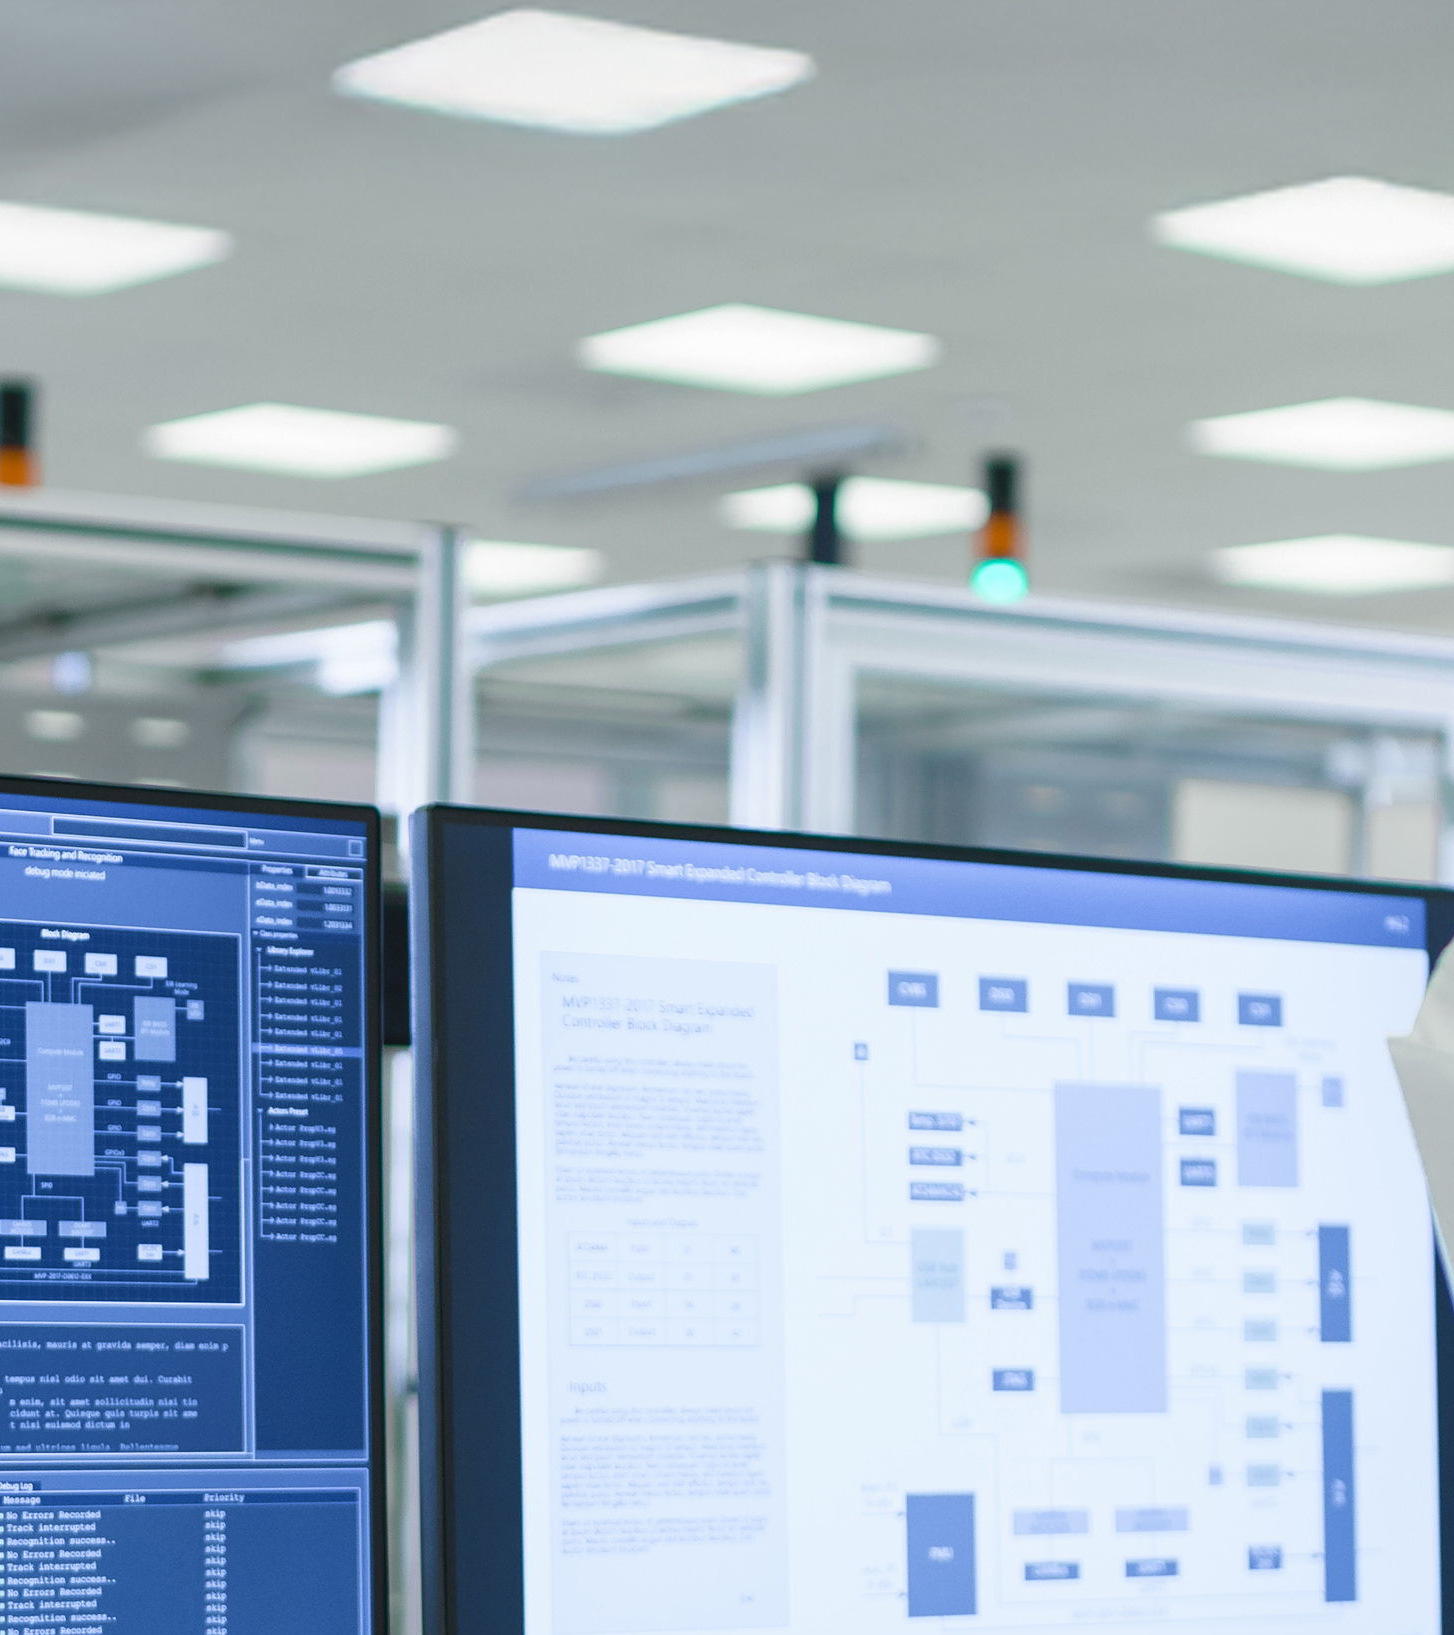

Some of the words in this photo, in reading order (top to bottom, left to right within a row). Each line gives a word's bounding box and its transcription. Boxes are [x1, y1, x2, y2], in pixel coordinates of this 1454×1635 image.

[8, 846, 27, 856] Face
[29, 847, 60, 861] Tracking
[61, 850, 77, 860] and
[78, 850, 123, 864] Recognition
[25, 866, 50, 878] debug
[51, 868, 74, 878] mode
[646, 861, 684, 879] Smart
[685, 864, 744, 883] Expanded
[747, 867, 804, 888] Controller
[806, 873, 838, 889] Block
[842, 875, 892, 896] Diagram
[41, 928, 60, 939] Block
[61, 929, 90, 941] Diagram
[20, 1482, 33, 1491] Log
[4, 1496, 41, 1505] Message
[125, 1494, 145, 1503] File
[204, 1493, 245, 1503] Priority
[7, 1511, 18, 1519] No
[23, 1511, 55, 1519] Errors
[59, 1509, 101, 1519] Recorded
[7, 1523, 34, 1532] Track
[38, 1522, 95, 1532] interrupted
[7, 1536, 65, 1546] Recognition
